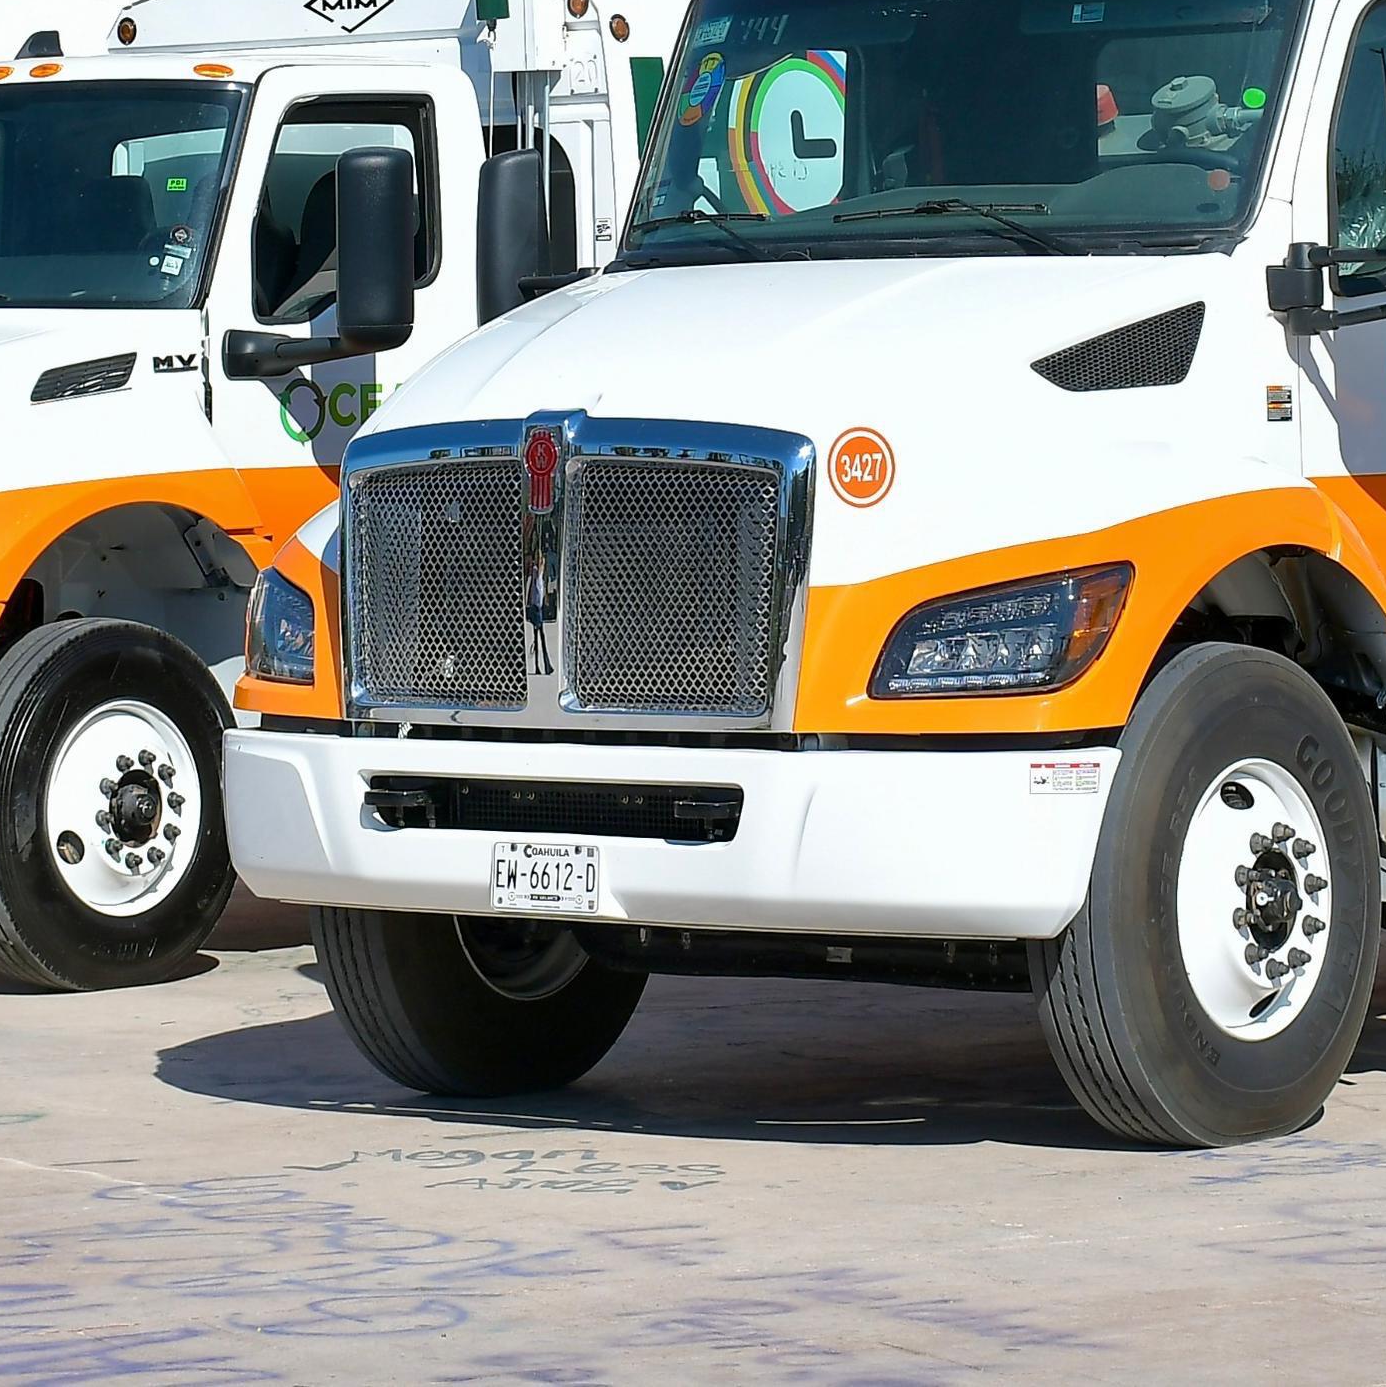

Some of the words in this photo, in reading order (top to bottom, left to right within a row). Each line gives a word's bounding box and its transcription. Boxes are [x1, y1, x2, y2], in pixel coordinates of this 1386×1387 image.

[840, 452, 883, 483] 3427
[523, 844, 570, 858] COAHUILA
[496, 859, 596, 892] EW-6612-D
